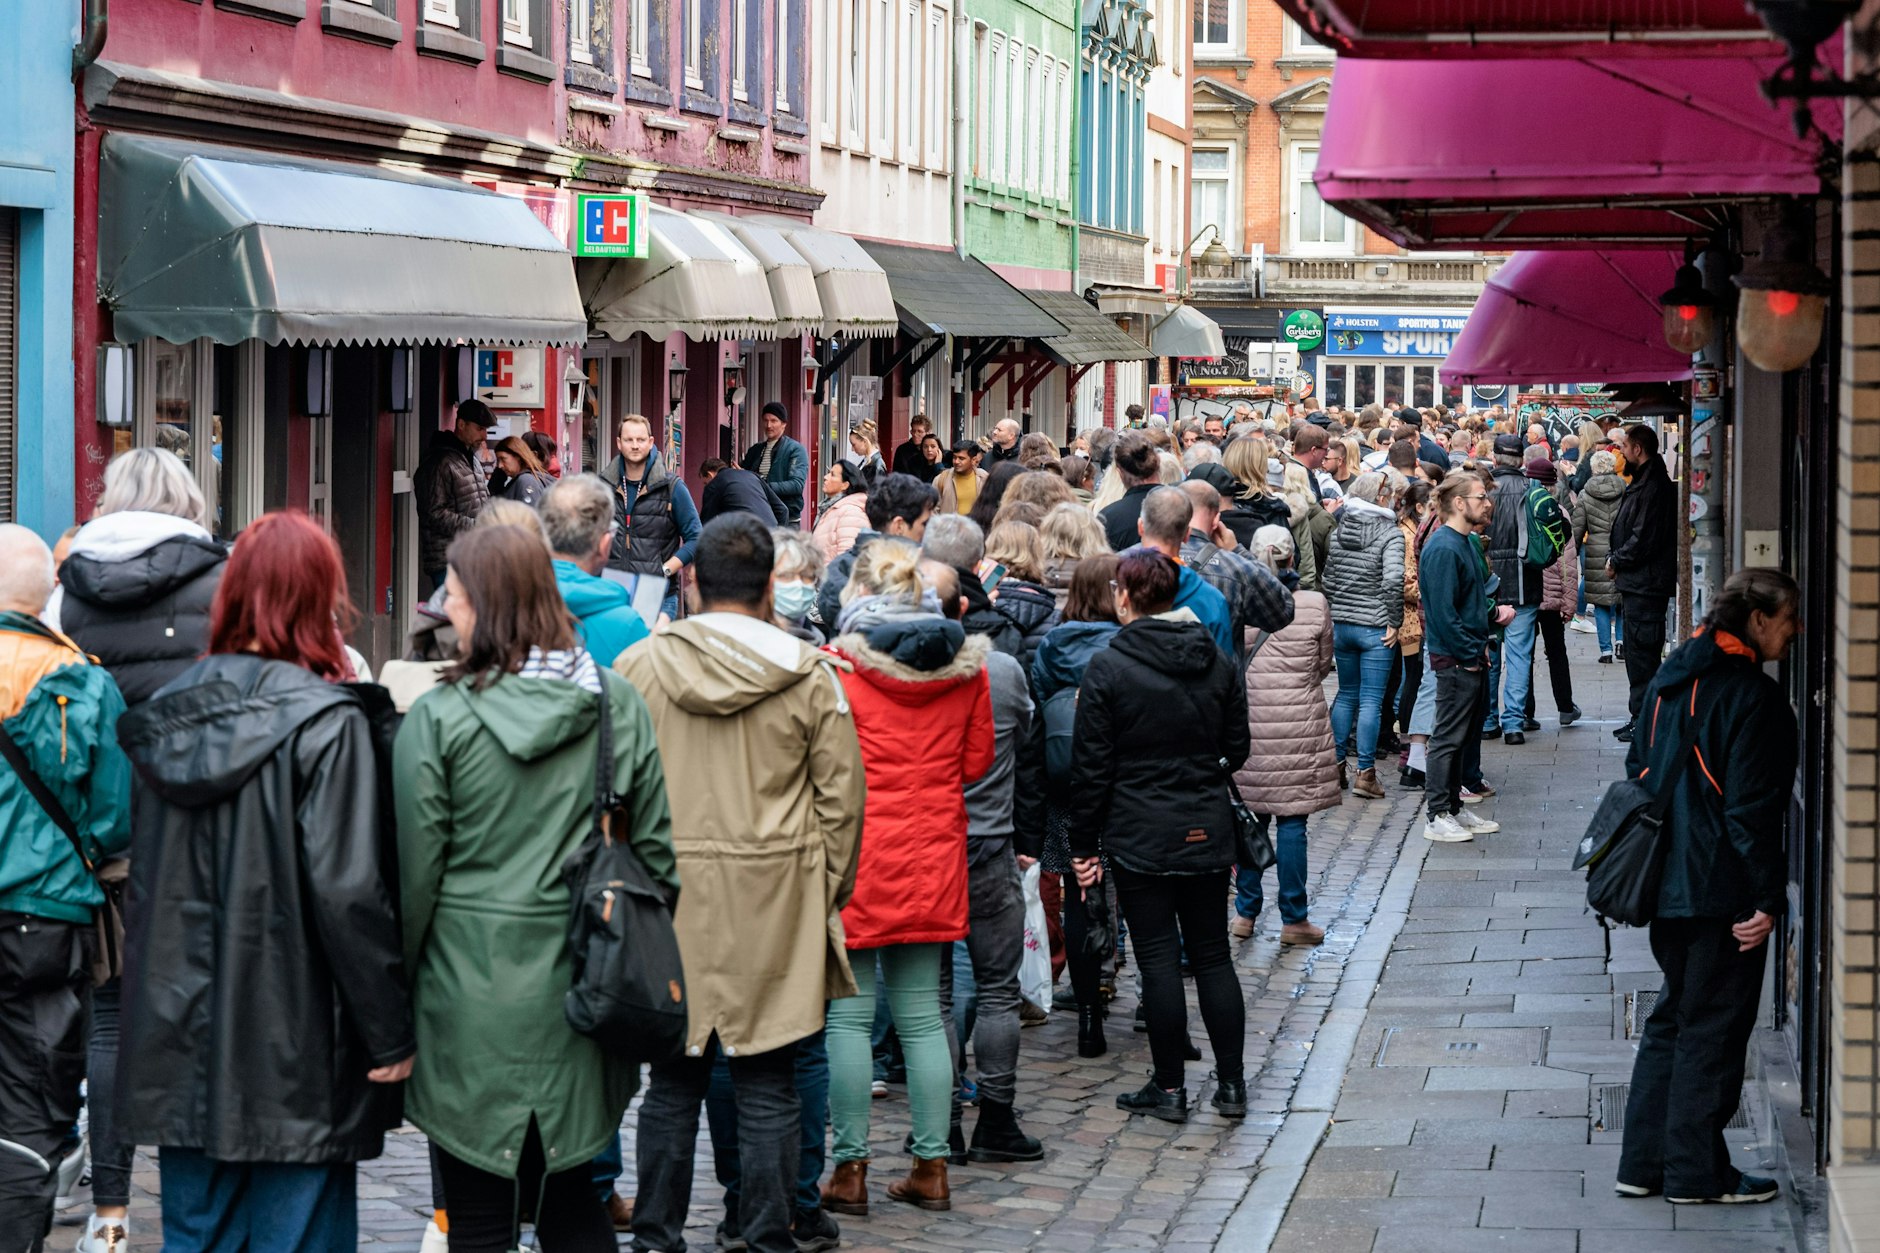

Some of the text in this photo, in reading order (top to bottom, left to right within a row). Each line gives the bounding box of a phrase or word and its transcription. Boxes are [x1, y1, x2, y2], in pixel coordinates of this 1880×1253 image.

[584, 245, 630, 254] GELDAUTOMAT
[1346, 318, 1379, 327] HOLSTEN
[1398, 317, 1440, 329] SPORTPUB
[1285, 324, 1322, 341] Carlsberg
